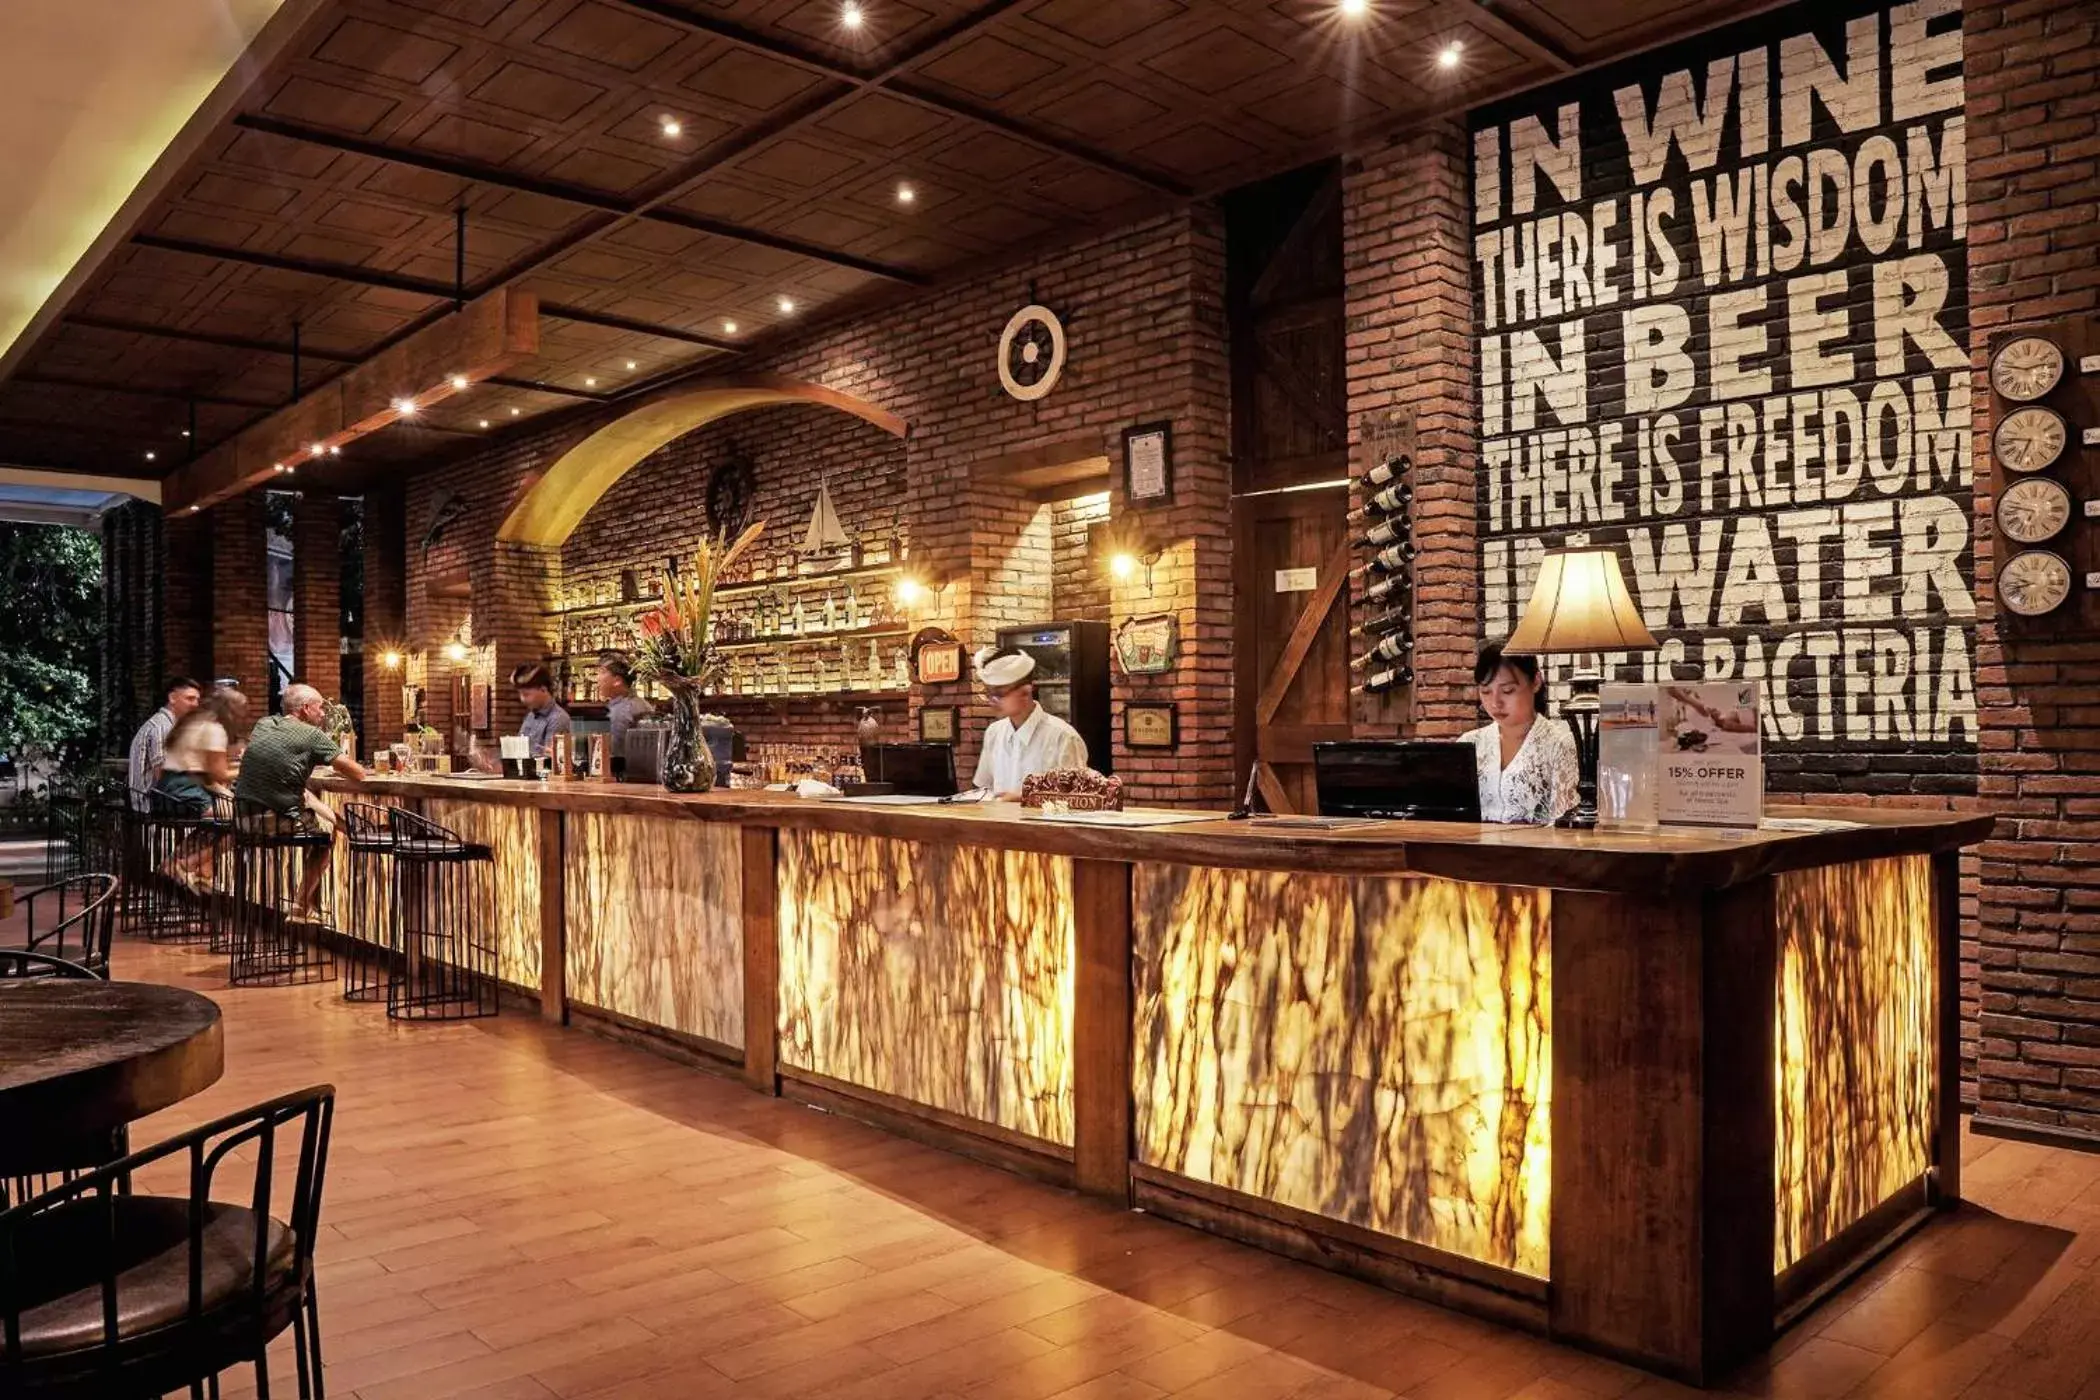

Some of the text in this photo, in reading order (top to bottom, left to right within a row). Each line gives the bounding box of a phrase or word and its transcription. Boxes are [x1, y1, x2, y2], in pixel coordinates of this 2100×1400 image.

[1475, 0, 1965, 224] IN WINE
[1475, 116, 1969, 329] THERE IS WISDOM
[1480, 253, 1971, 438] IN BEER
[1482, 371, 1972, 532] THERE IS FREEDOM
[1626, 496, 1976, 632] WATER
[1668, 766, 1746, 780] 15% OFFER
